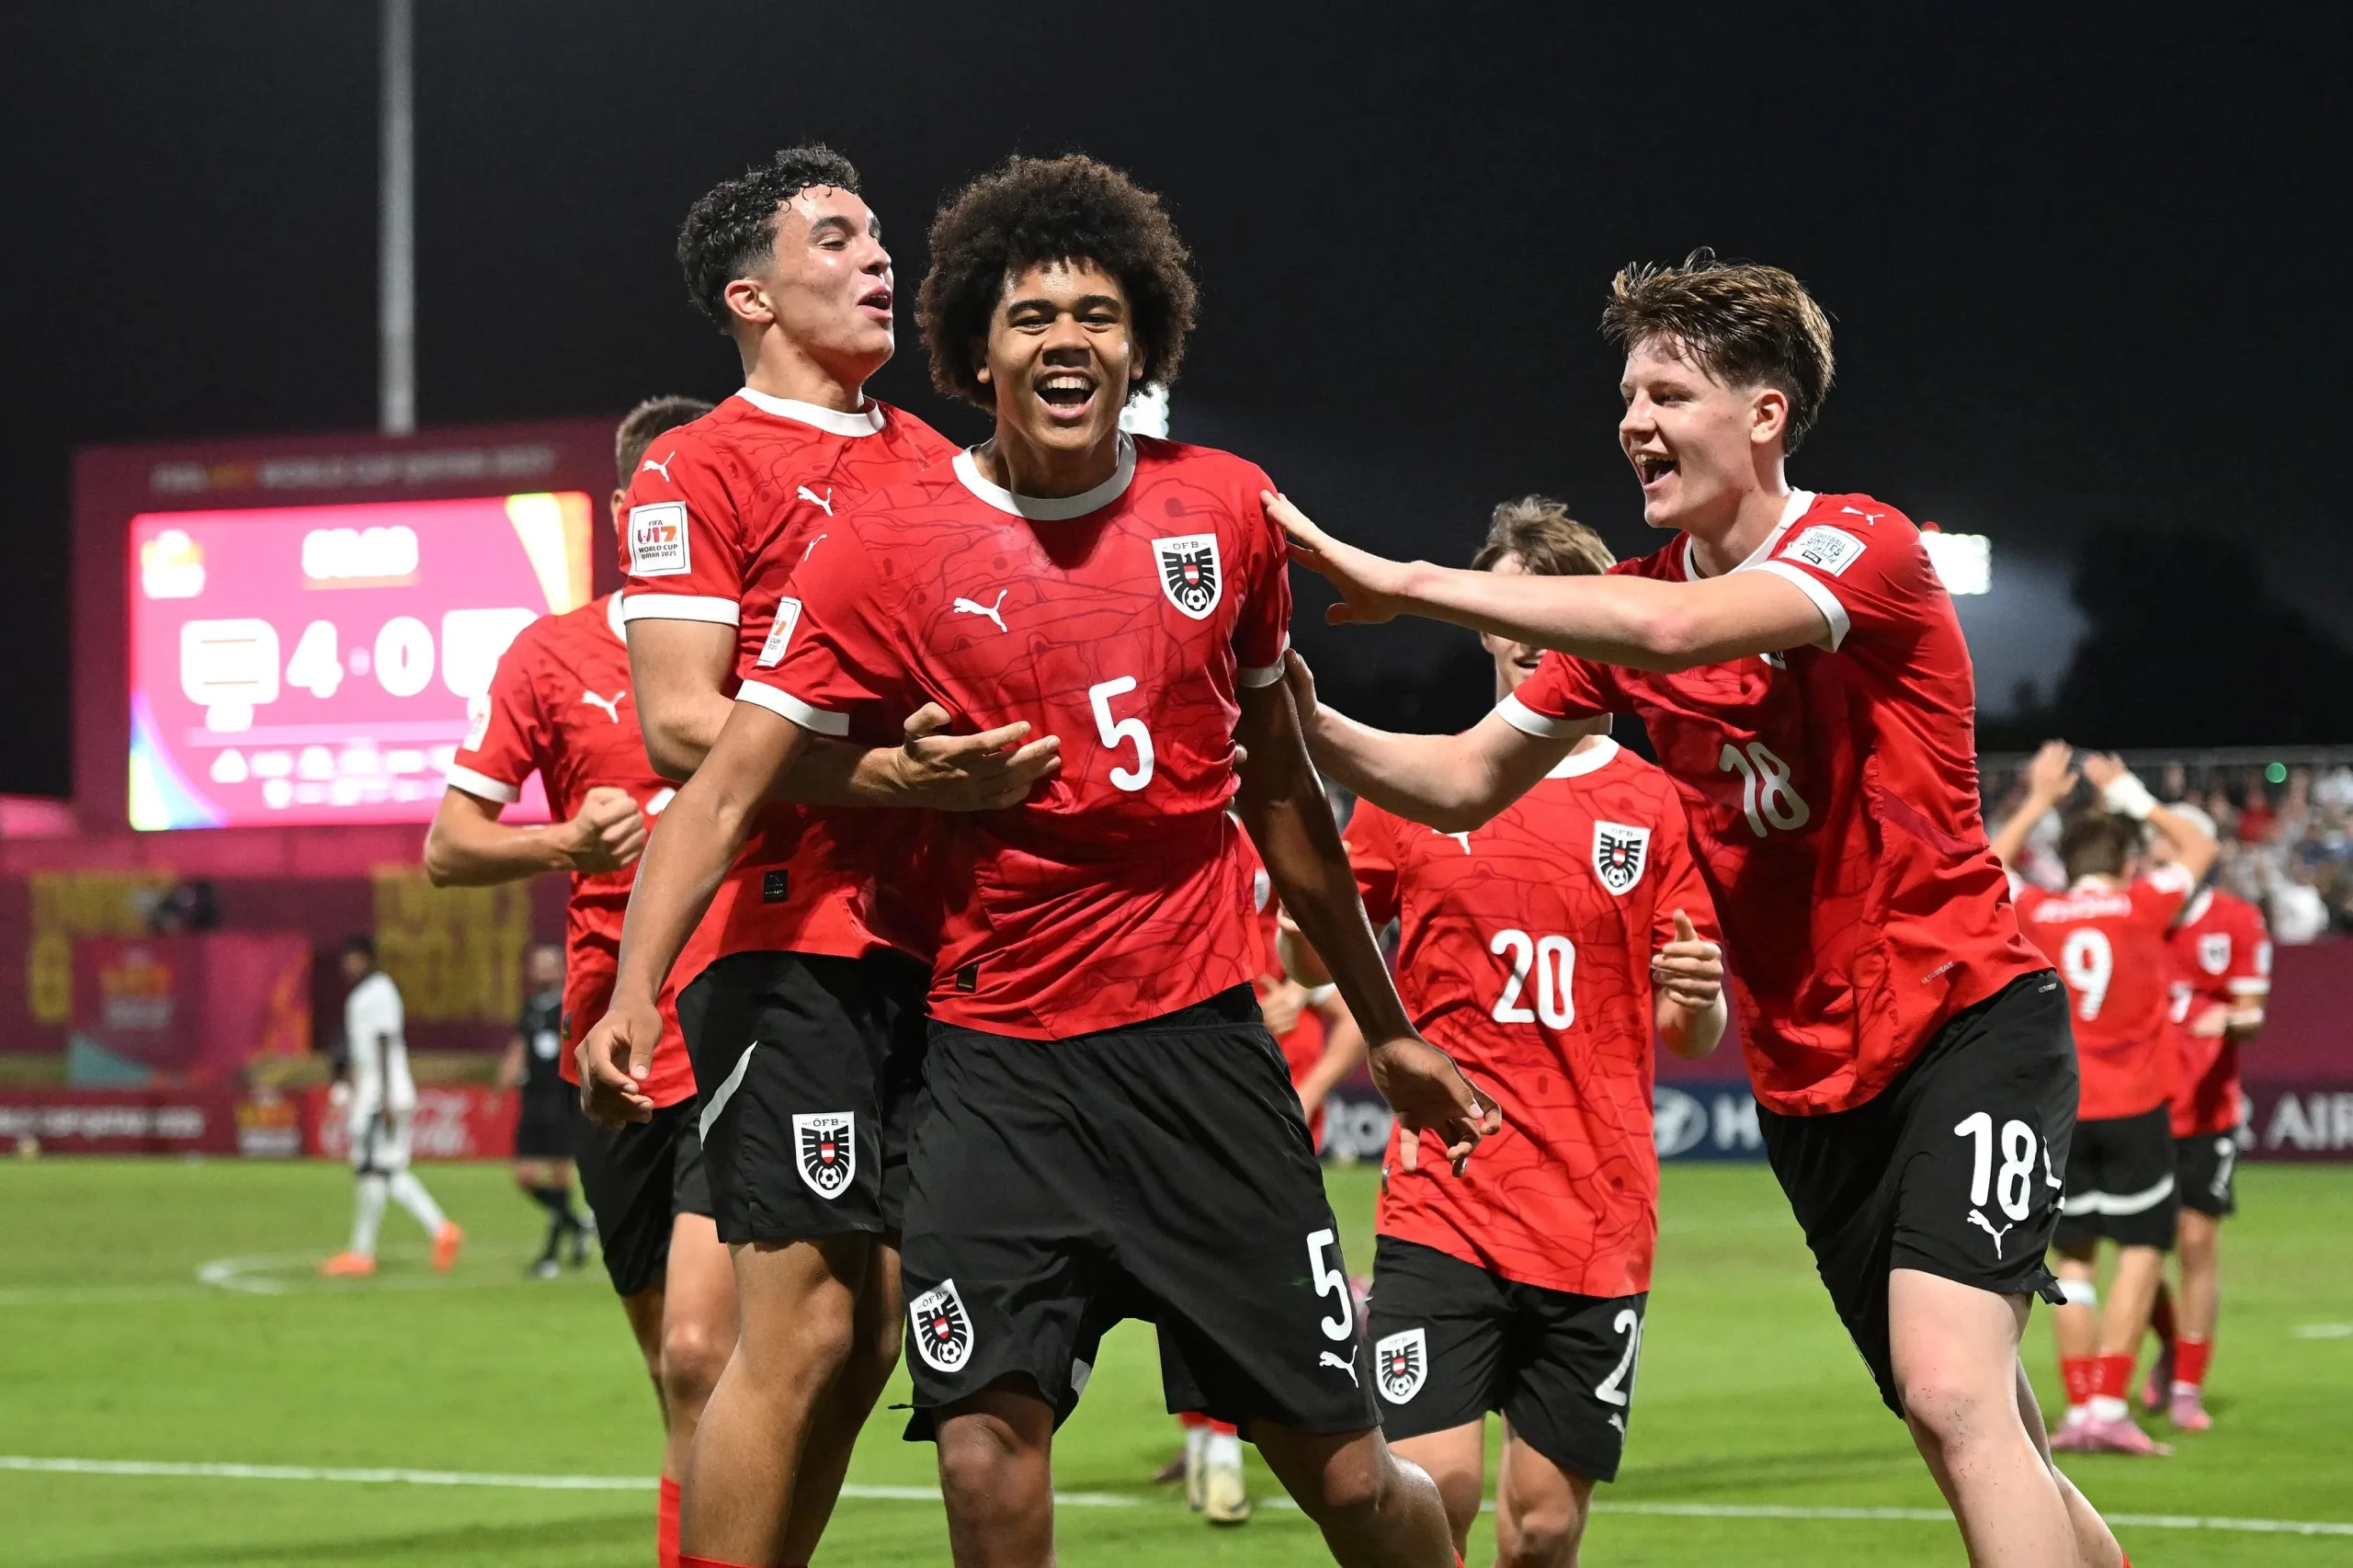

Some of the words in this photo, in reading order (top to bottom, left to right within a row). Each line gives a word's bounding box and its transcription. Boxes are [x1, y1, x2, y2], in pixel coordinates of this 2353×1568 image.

[639, 545, 662, 553] WORLD
[287, 620, 344, 699] 4
[374, 617, 435, 697] 0
[1088, 675, 1154, 791] 5
[1719, 742, 1810, 838] 18
[1490, 929, 1575, 1030] 20
[2062, 927, 2113, 1021] 9
[1954, 1111, 2037, 1221] 18
[1306, 1228, 1356, 1342] 5
[1595, 1309, 1644, 1407] 2
